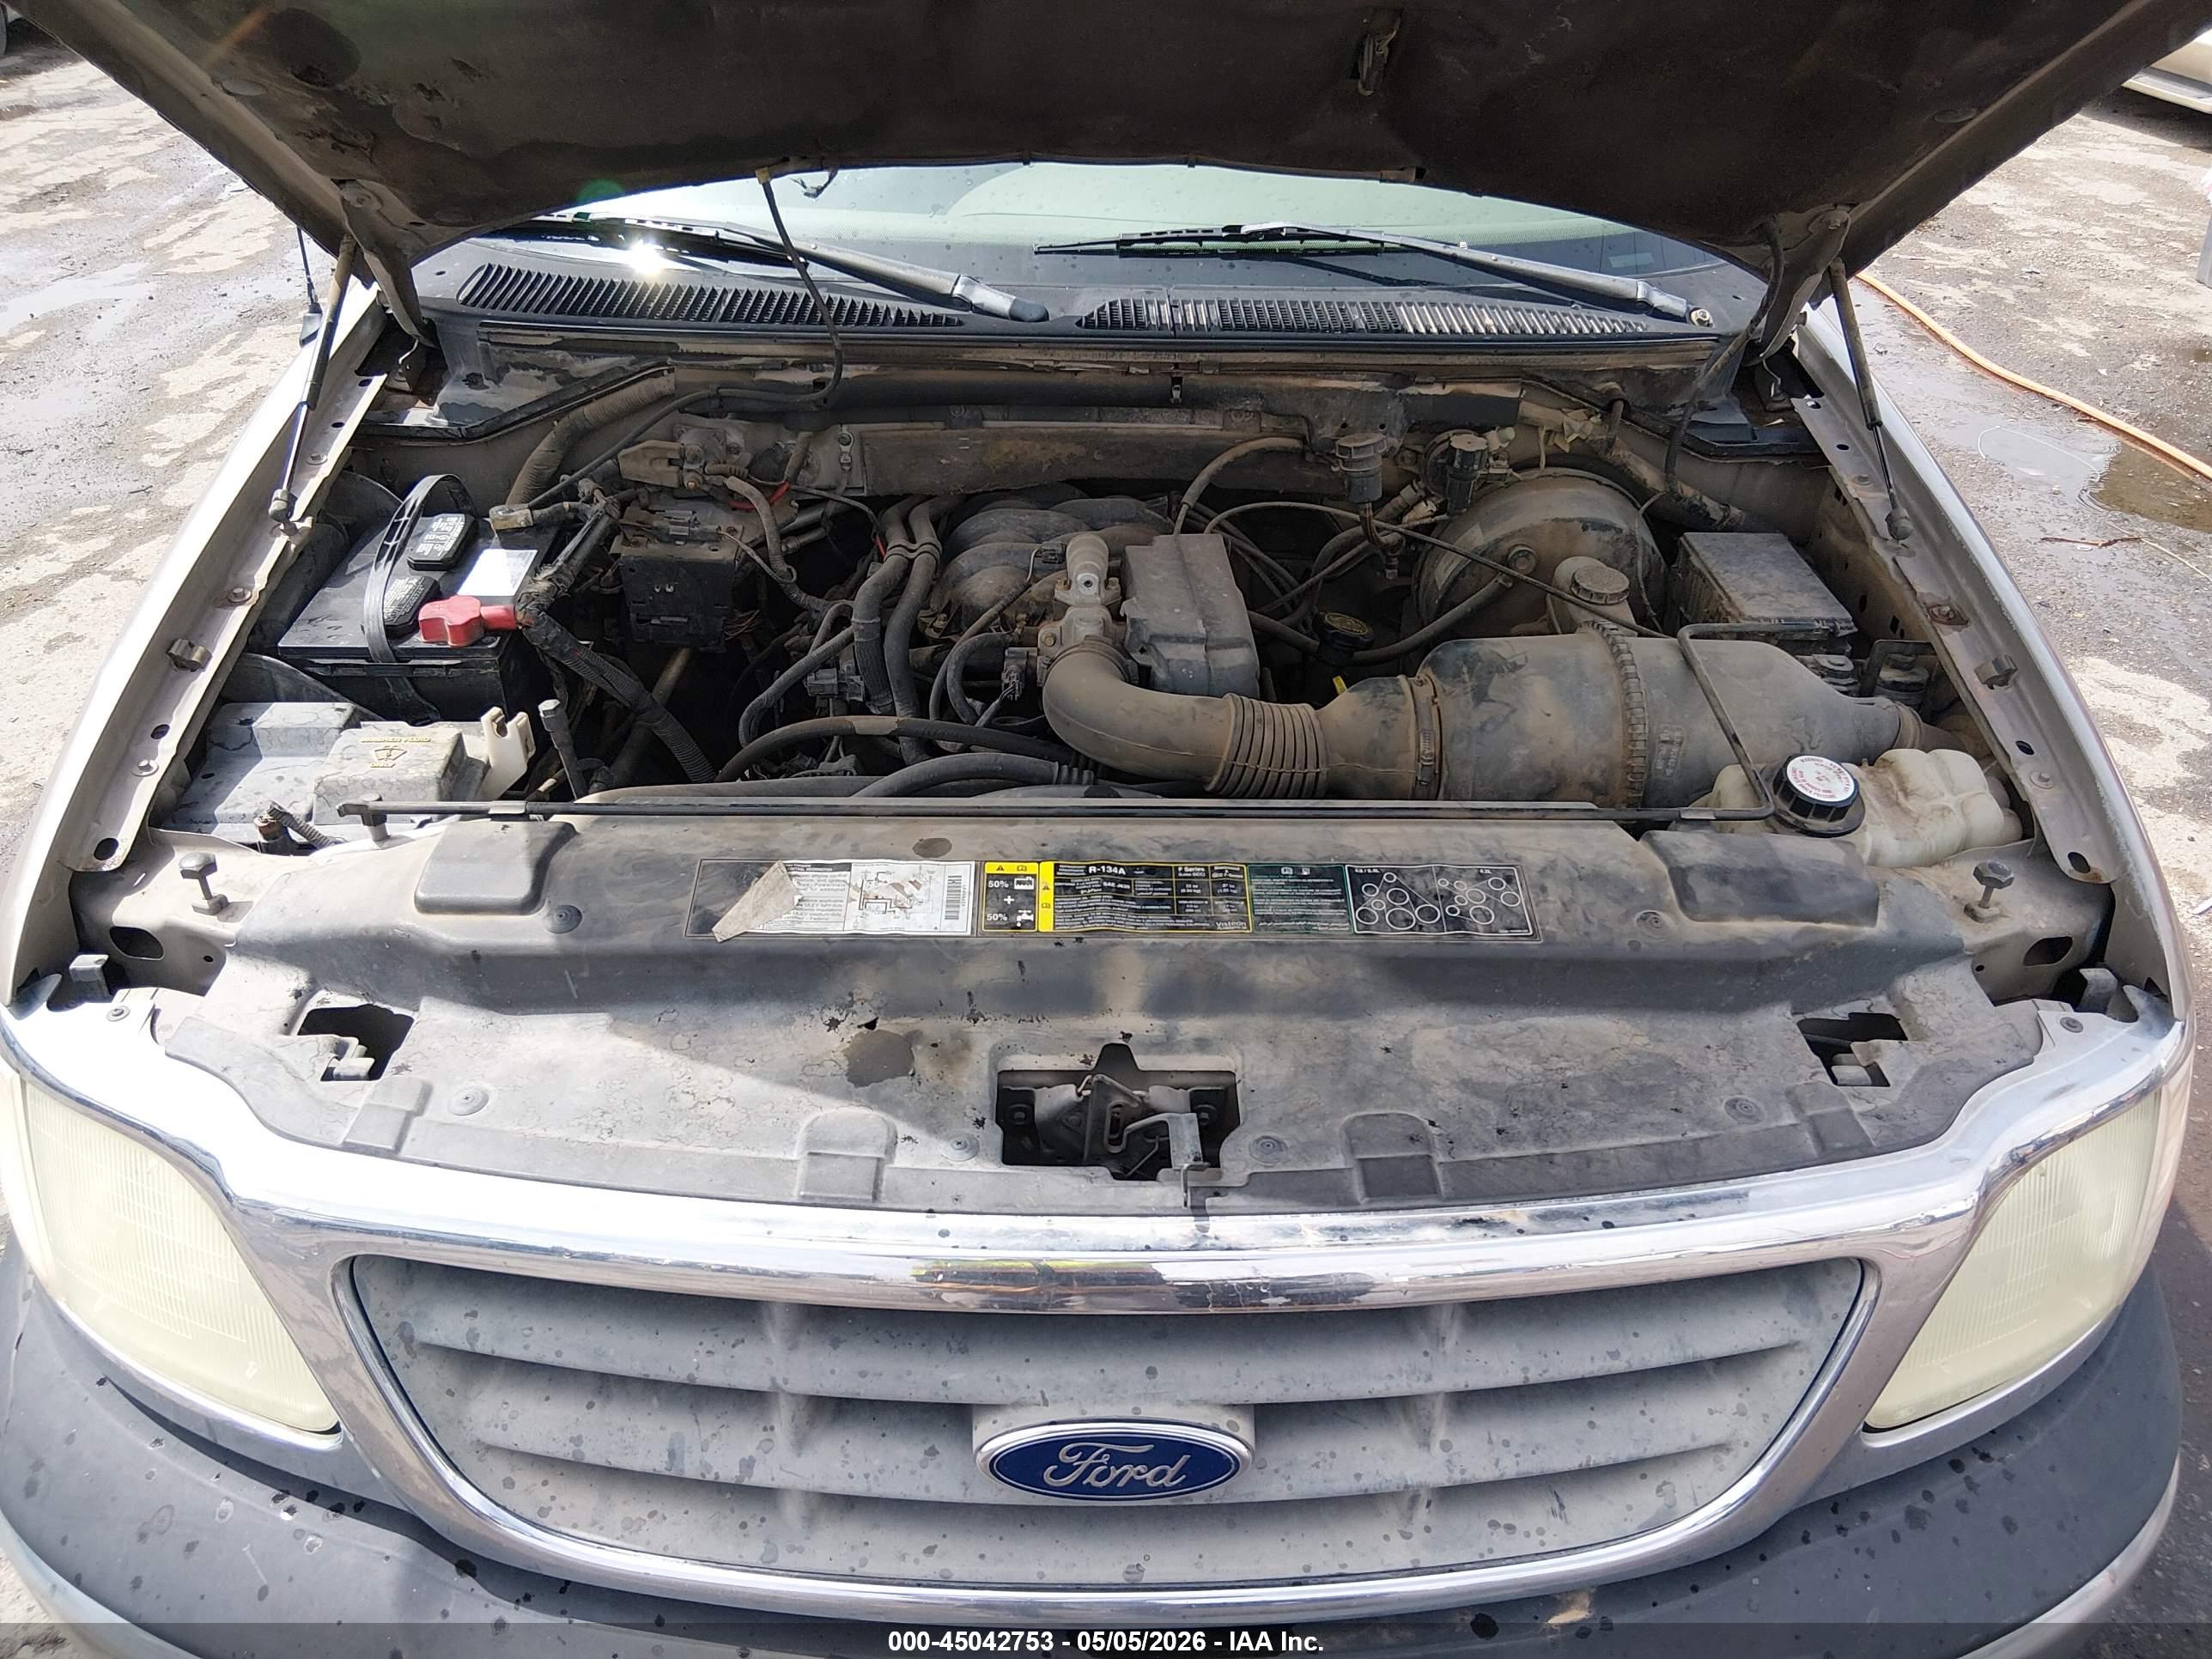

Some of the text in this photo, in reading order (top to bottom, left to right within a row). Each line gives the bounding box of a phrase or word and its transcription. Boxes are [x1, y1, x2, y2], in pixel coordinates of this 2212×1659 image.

[1088, 865, 1127, 875] R-134A
[986, 913, 1008, 921] 50%
[1042, 1441, 1192, 1488] Ford
